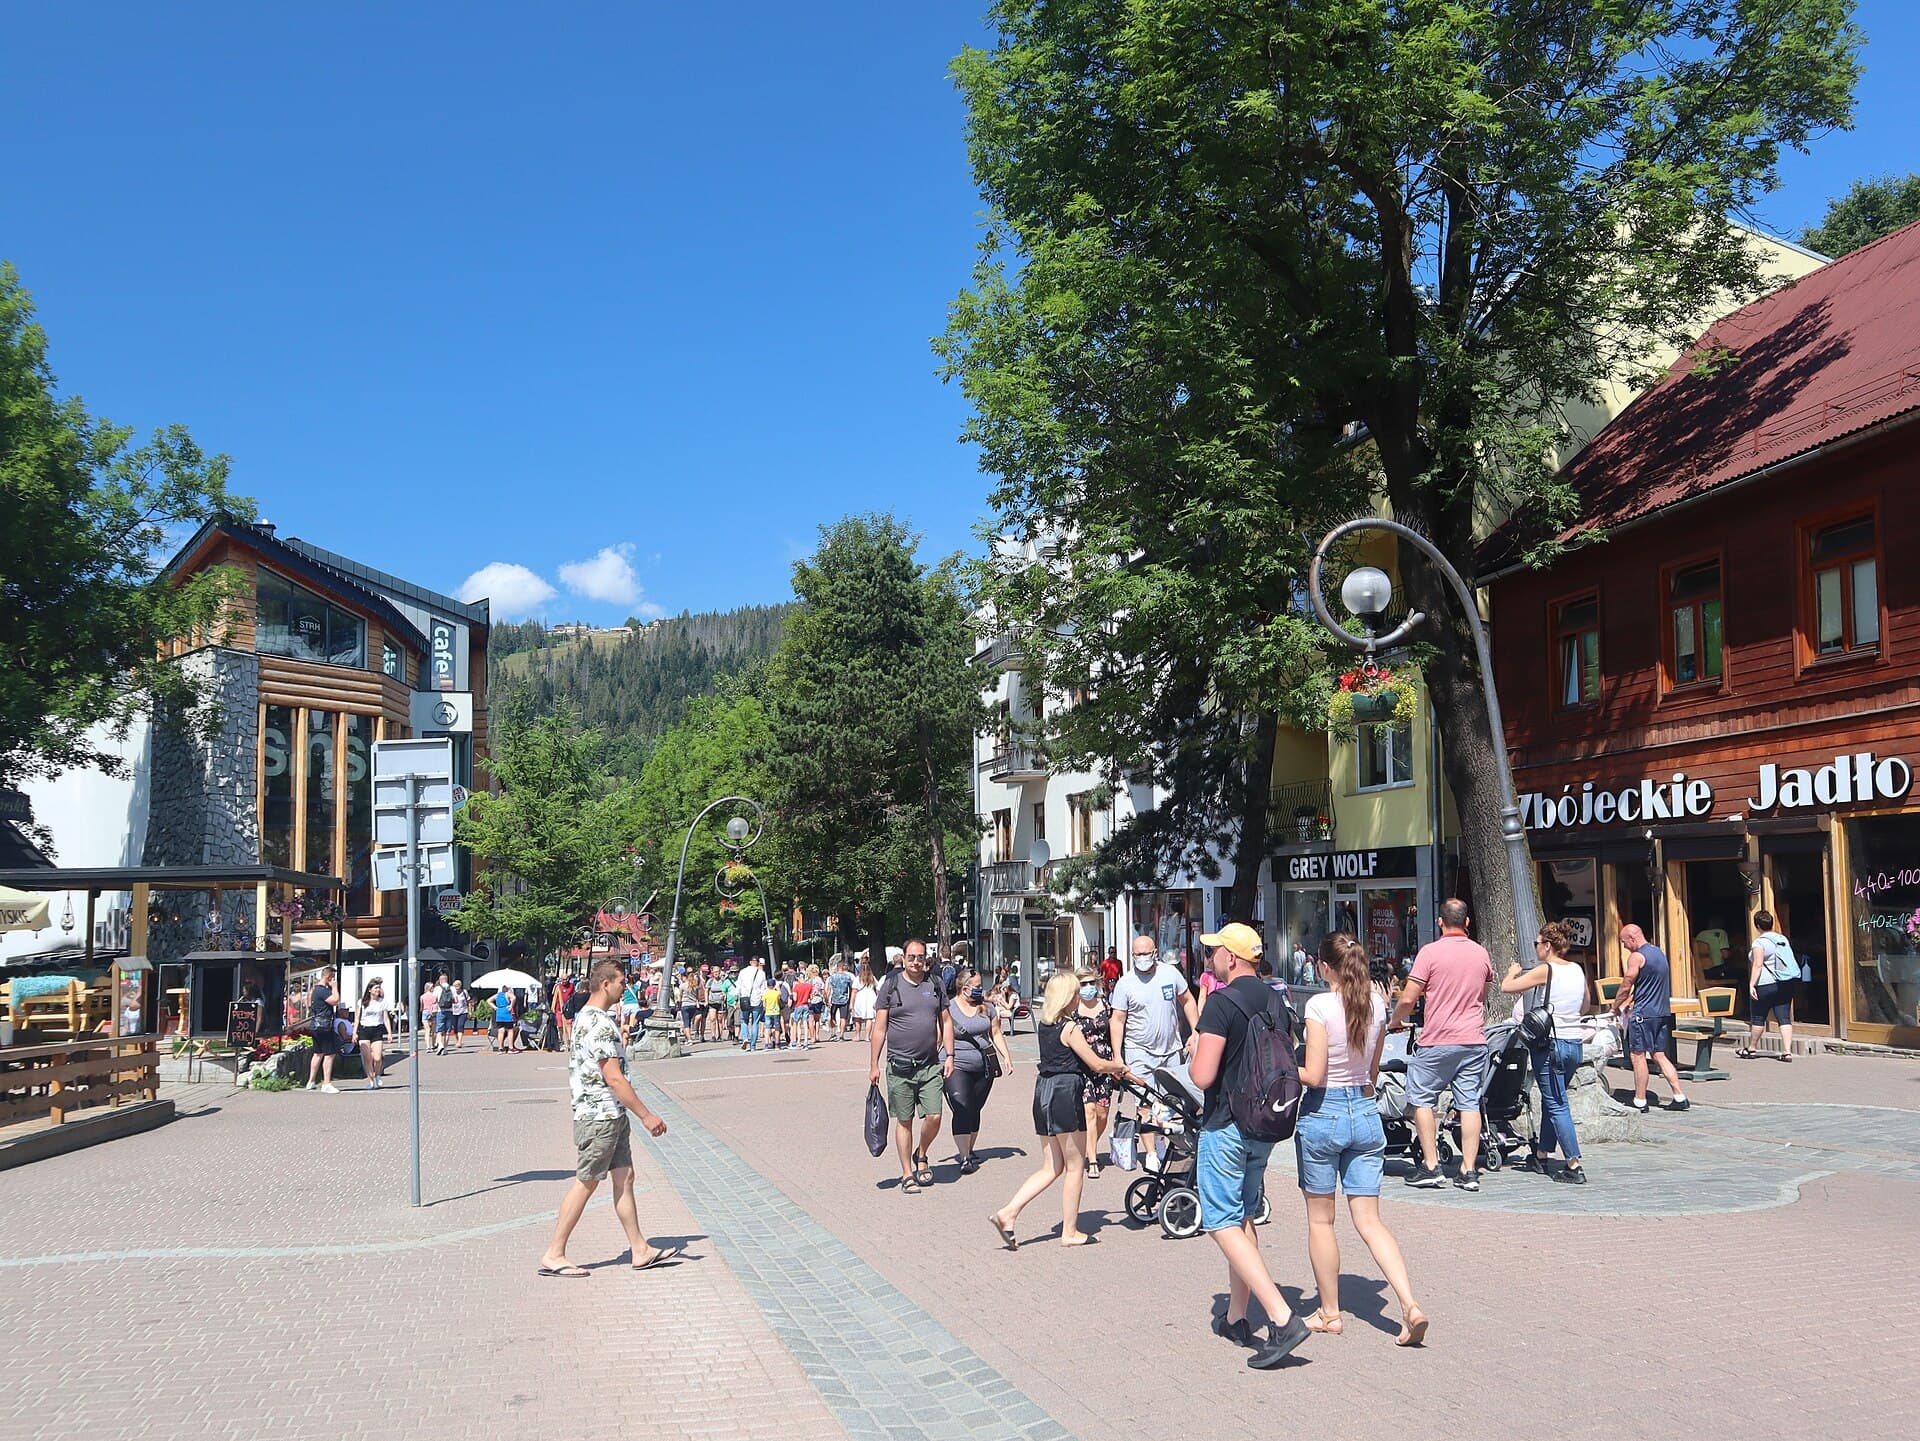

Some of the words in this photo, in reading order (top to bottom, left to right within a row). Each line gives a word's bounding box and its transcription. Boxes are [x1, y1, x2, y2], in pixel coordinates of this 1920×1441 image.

[434, 626, 453, 674] cafe
[1748, 752, 1911, 811] Jadło
[1289, 856, 1328, 879] GREY
[1333, 852, 1378, 877] WOLF
